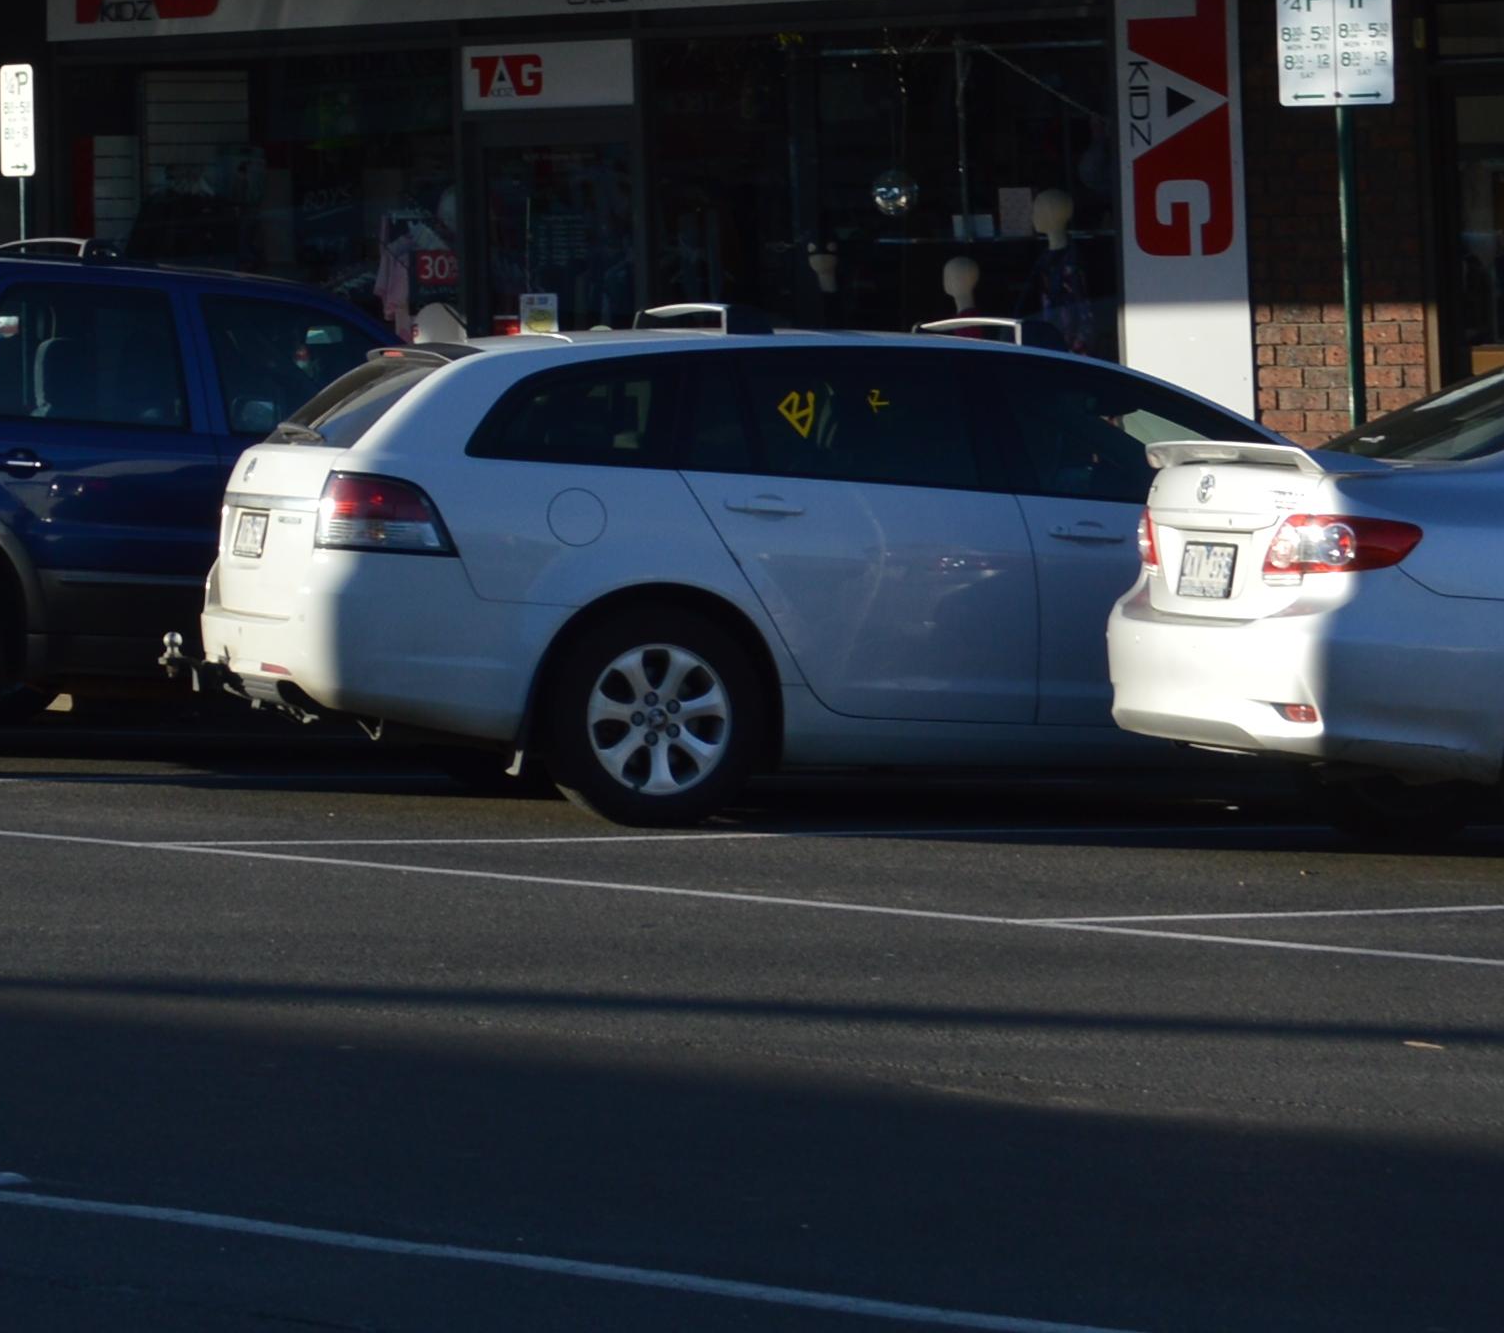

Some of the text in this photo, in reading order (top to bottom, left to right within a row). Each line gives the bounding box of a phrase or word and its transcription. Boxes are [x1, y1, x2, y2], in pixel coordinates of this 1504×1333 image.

[99, 0, 154, 23] KIDZ
[471, 54, 543, 97] TAG
[1127, 59, 1153, 148] KIDZ
